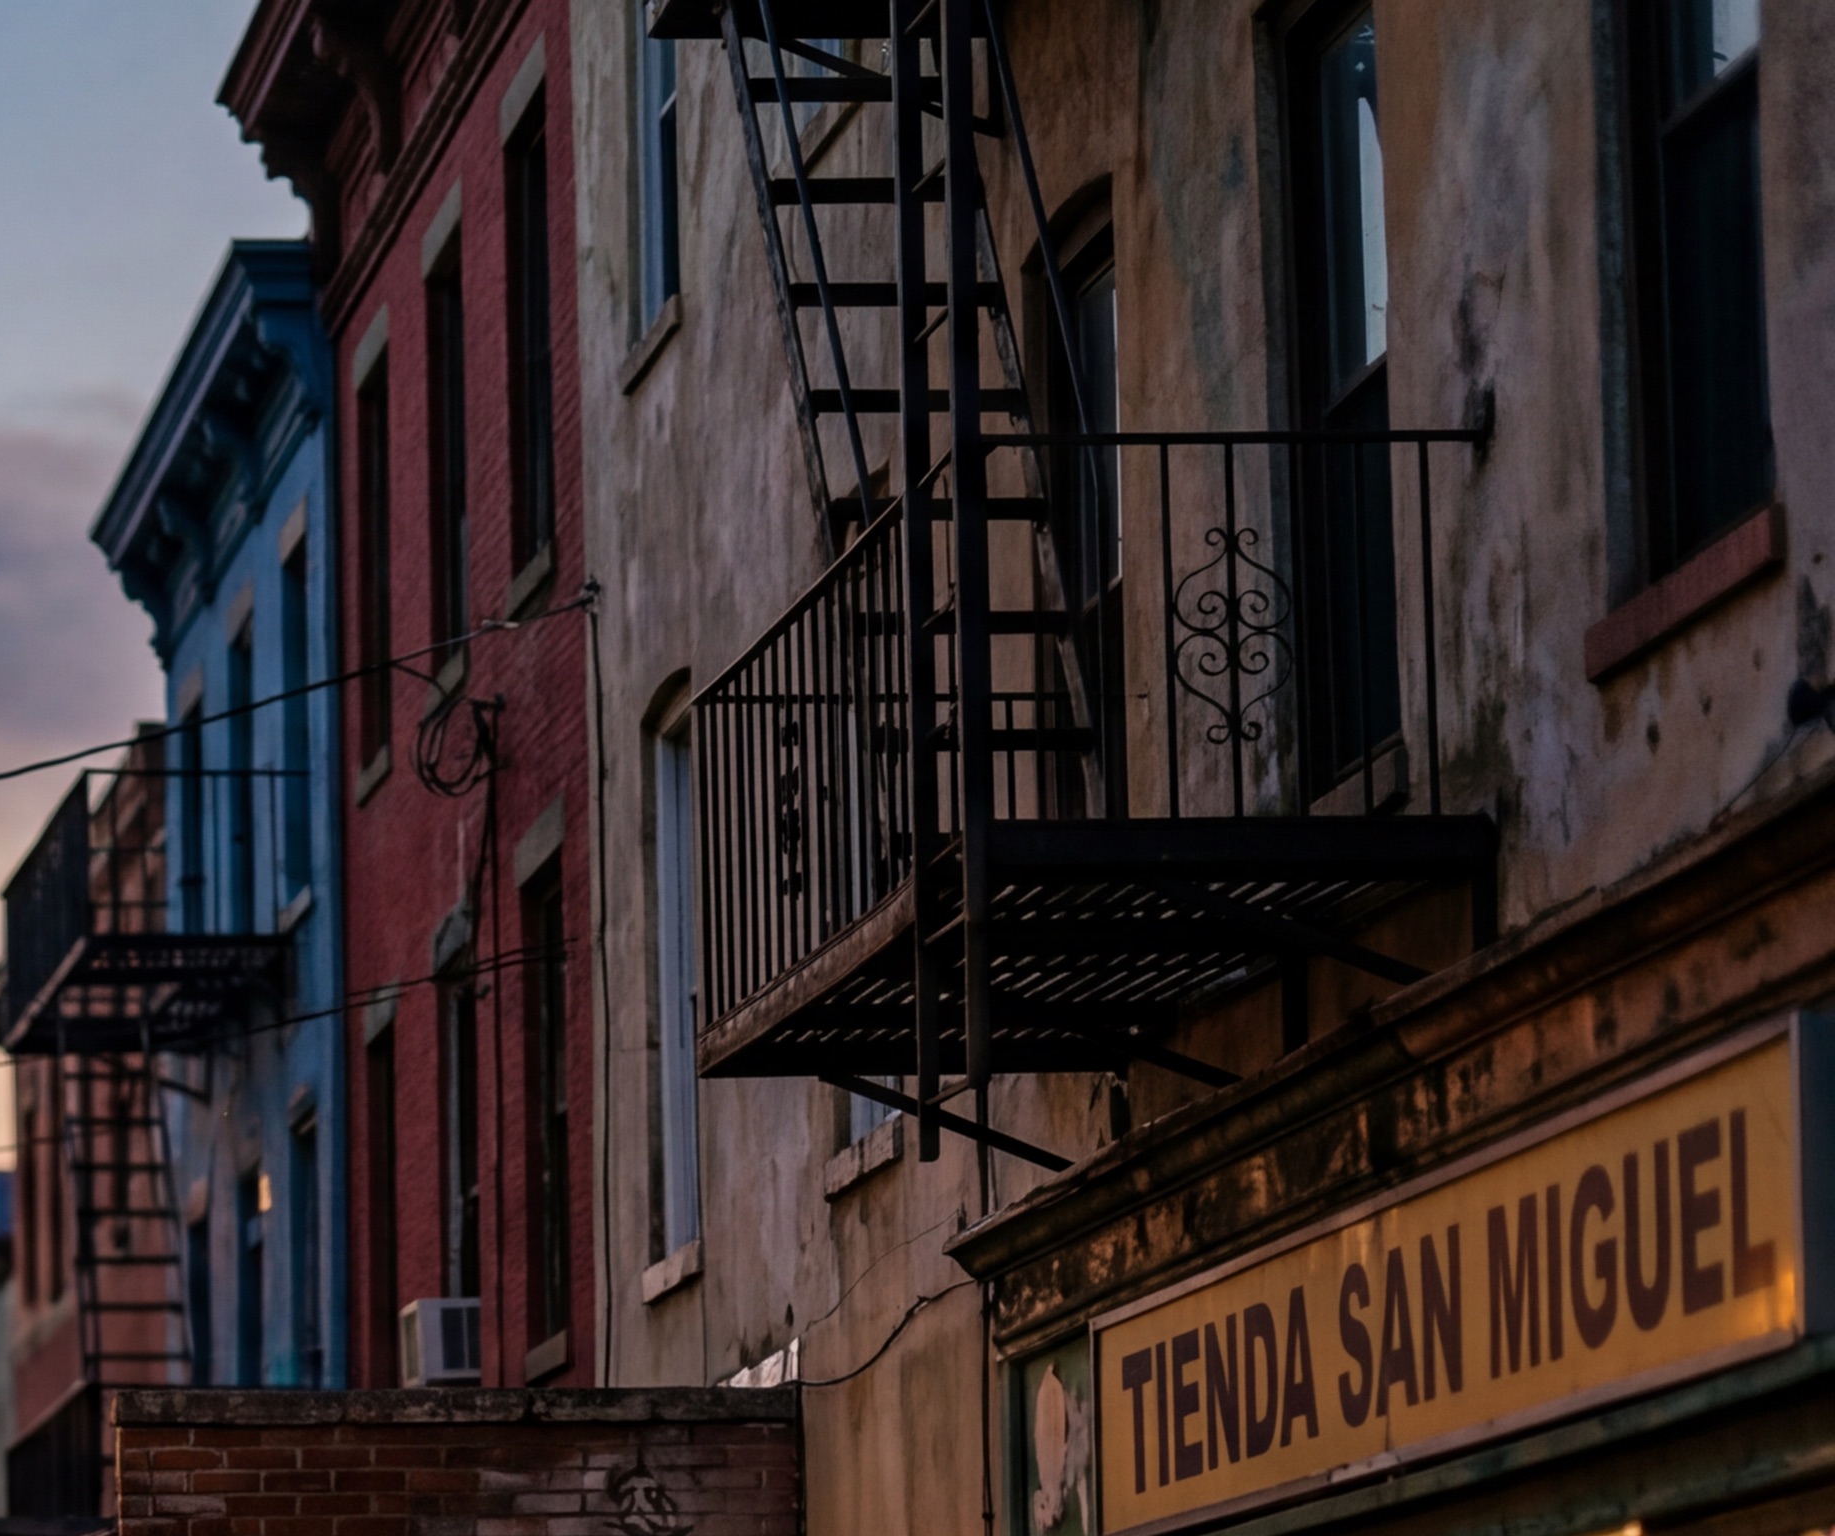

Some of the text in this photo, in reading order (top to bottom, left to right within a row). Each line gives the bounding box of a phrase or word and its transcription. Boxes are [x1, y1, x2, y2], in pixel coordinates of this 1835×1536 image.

[1121, 1107, 1777, 1495] TIENDA SAN MIGUEL
